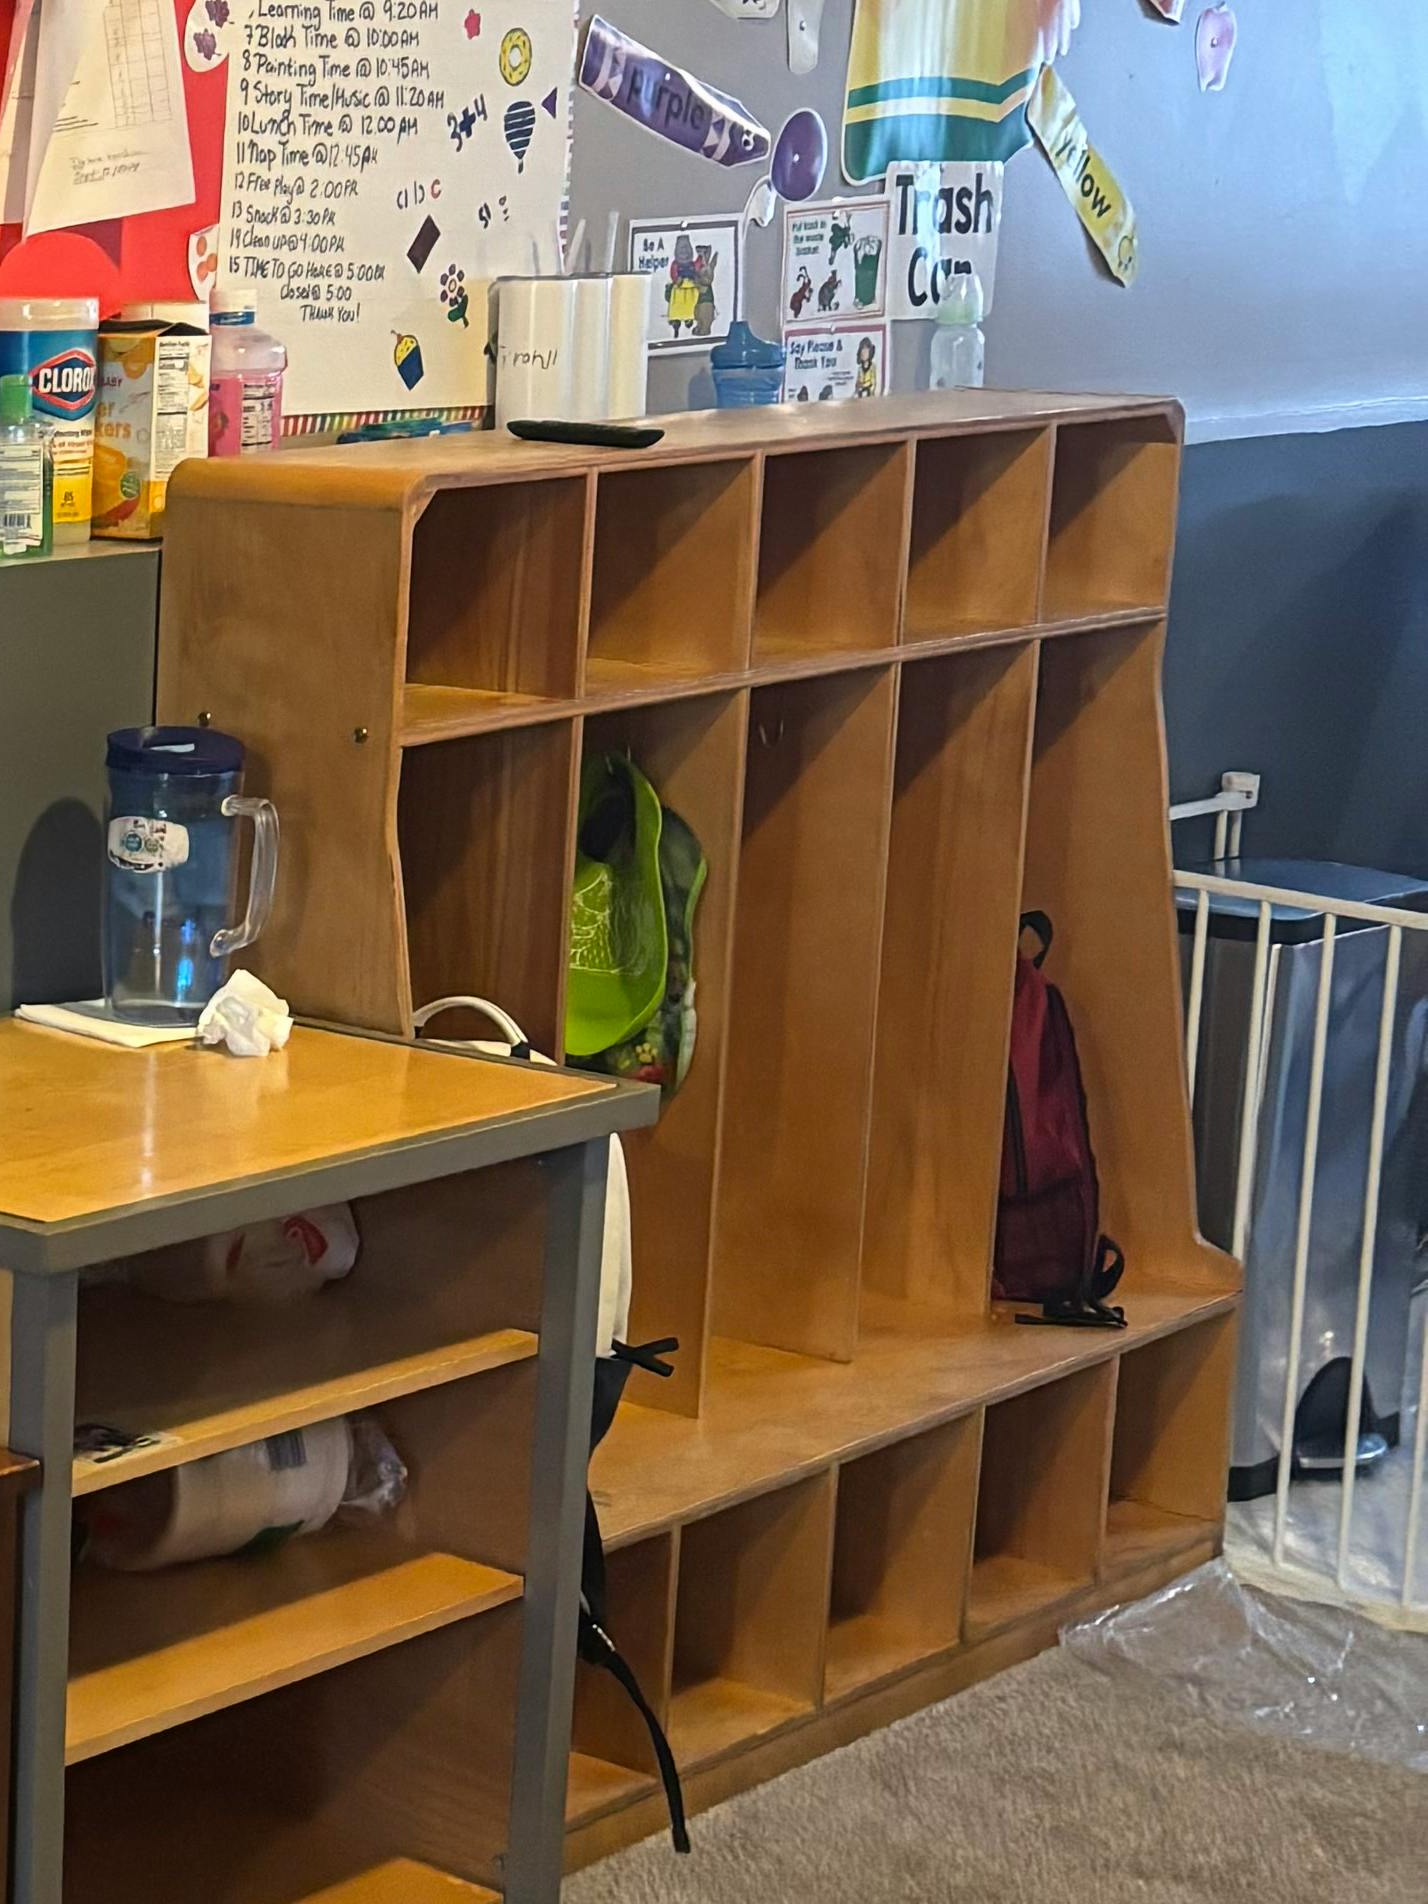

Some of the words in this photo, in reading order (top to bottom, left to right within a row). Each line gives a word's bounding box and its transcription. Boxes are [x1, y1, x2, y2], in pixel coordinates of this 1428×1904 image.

[358, 0, 375, 22] @
[243, 25, 254, 46] 7
[301, 23, 338, 50] Time
[344, 26, 361, 49] @
[242, 49, 252, 72] 8
[253, 52, 317, 87] Painting
[318, 54, 351, 80] Time
[355, 57, 372, 78] @
[240, 77, 249, 106] 9
[252, 78, 293, 111] Story
[374, 86, 390, 108] @
[626, 67, 705, 131] purple
[237, 111, 249, 136] 10
[250, 110, 297, 138] Lunch
[298, 113, 334, 138] Time
[338, 113, 353, 135] @
[236, 140, 245, 165] 11
[278, 139, 310, 168] Time
[246, 172, 272, 194] Free
[1054, 133, 1113, 219] yellow
[231, 200, 243, 219] 13
[895, 172, 994, 236] Trash
[642, 239, 656, 253] Be
[657, 237, 665, 251] A
[228, 255, 240, 274] 15
[637, 254, 670, 273] Helper
[38, 366, 95, 394] CLORO
